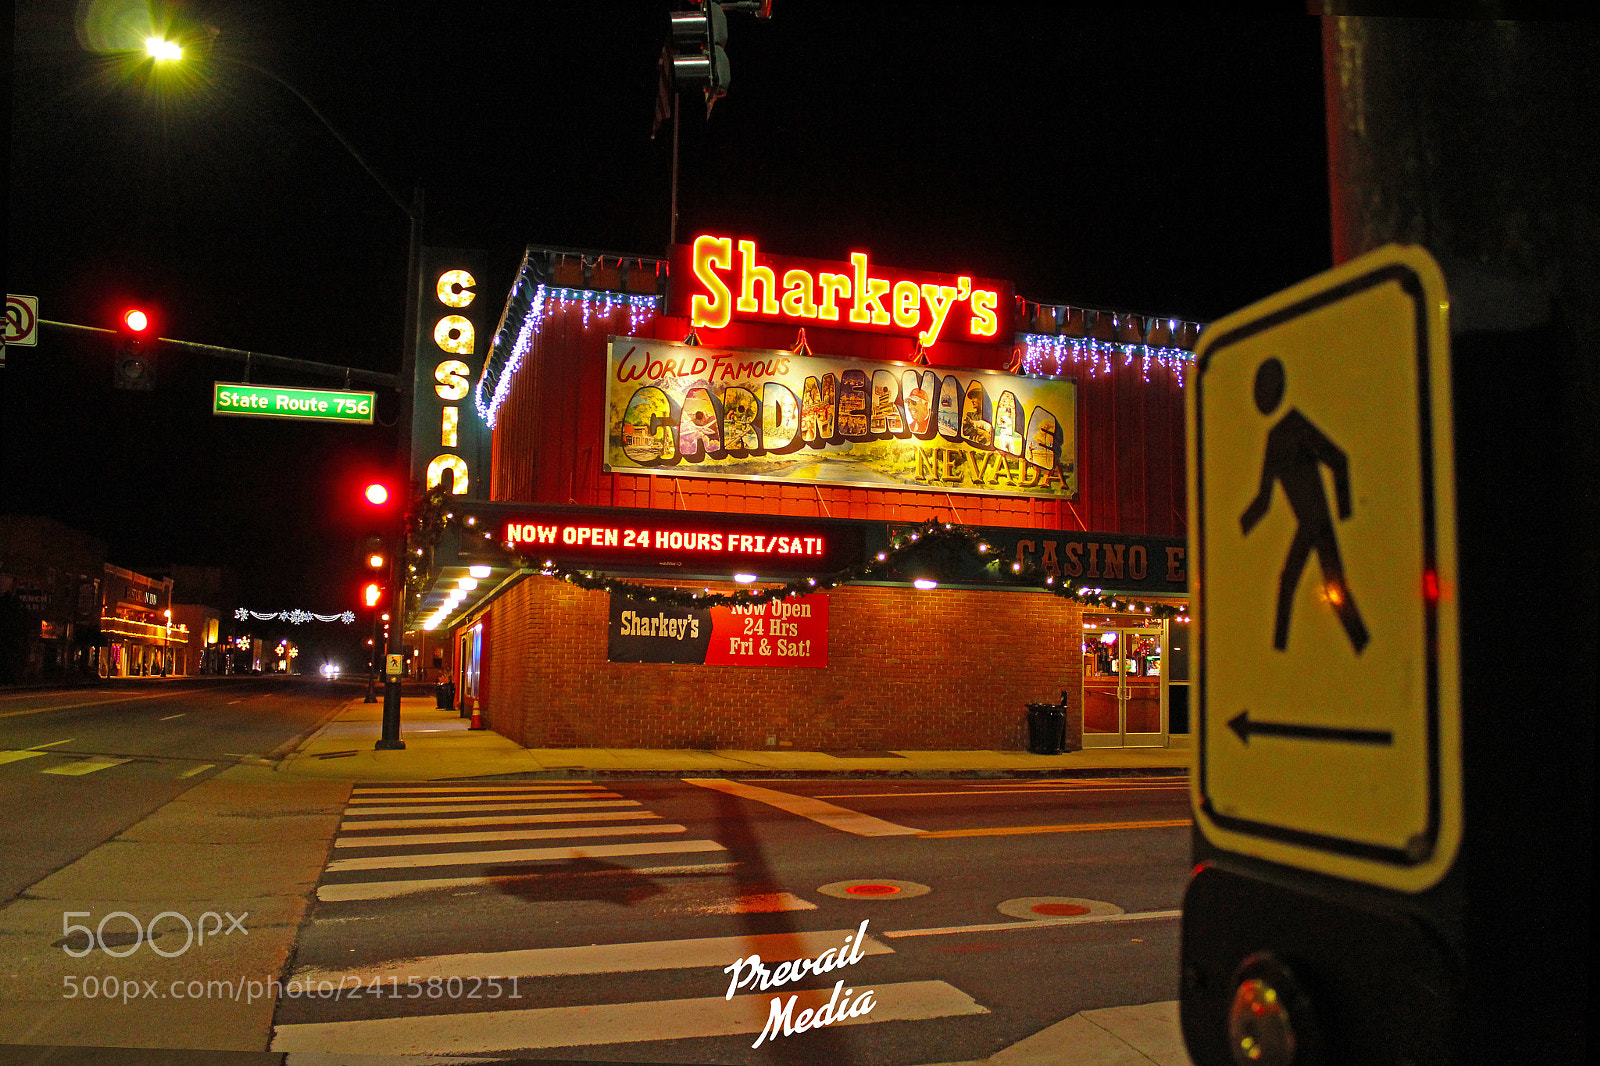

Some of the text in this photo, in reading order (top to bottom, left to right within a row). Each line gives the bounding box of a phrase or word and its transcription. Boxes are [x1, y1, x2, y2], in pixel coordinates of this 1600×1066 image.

[690, 233, 1000, 347] Sharkey's
[616, 346, 790, 383] WORLD FAMOUS
[218, 391, 370, 415] State Route 756
[622, 367, 1064, 471] GARDNERVILLE
[913, 446, 1069, 490] NEVADA
[507, 524, 824, 555] NOW OPEN 24 HOURS FRI/SAT!
[1015, 539, 1148, 580] CASINO
[771, 599, 812, 620] Open
[620, 610, 699, 641] Sharkey's
[743, 617, 798, 637] 24 Hrs
[729, 637, 811, 657] Fri & Sat!
